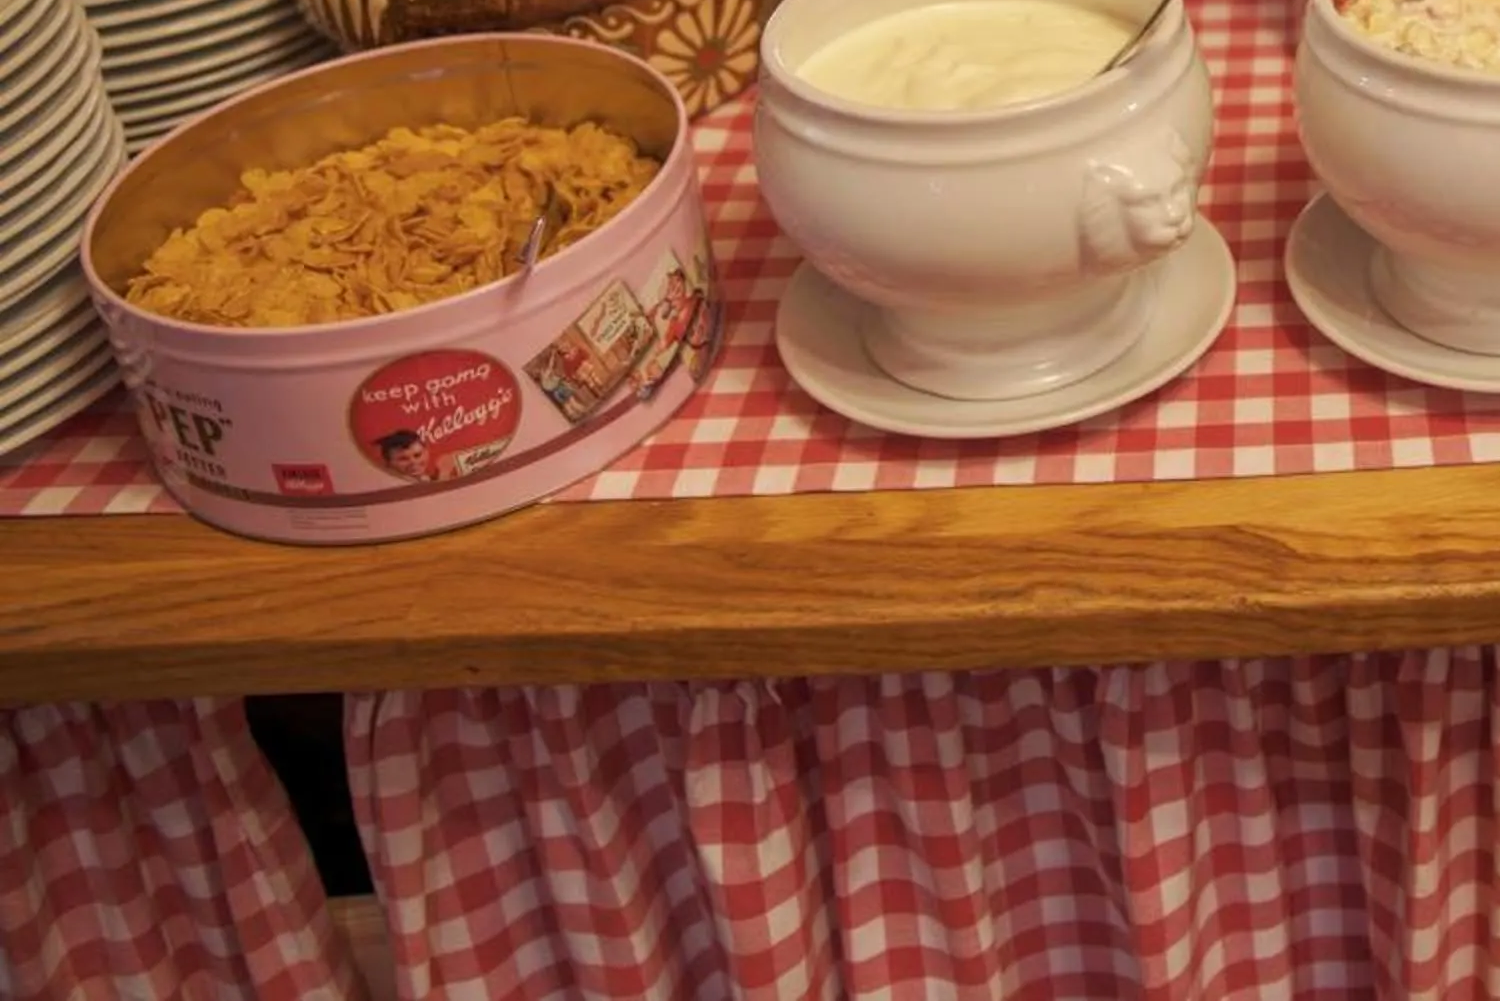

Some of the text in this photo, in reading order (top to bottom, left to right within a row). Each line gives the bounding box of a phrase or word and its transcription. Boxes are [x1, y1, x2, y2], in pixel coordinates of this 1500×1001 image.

[361, 383, 419, 404] keep
[402, 392, 457, 415] with
[417, 387, 513, 443] Kellogg's
